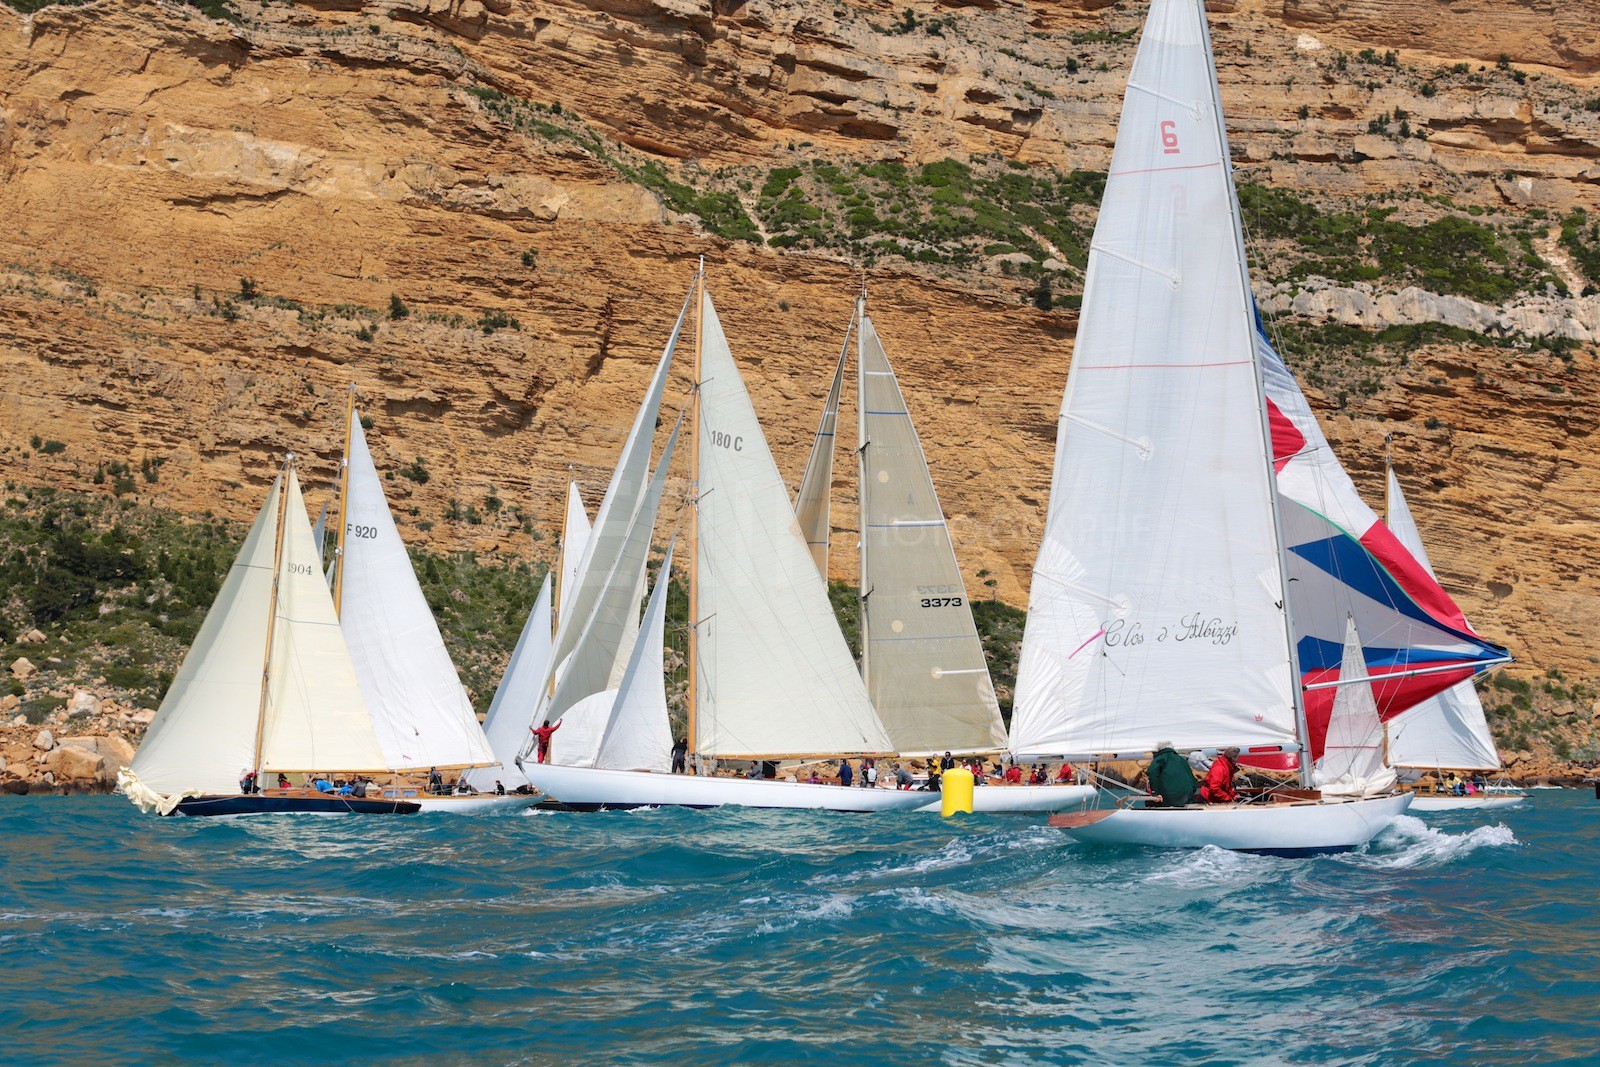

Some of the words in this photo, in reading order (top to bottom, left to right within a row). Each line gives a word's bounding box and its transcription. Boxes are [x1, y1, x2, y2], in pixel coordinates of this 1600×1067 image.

[1160, 120, 1178, 148] 6
[711, 430, 731, 449] 180
[734, 436, 743, 451] C
[346, 523, 353, 536] F
[355, 525, 378, 539] 920
[288, 562, 312, 575] 1904
[920, 597, 962, 608] 3373
[1101, 619, 1144, 647] Clos
